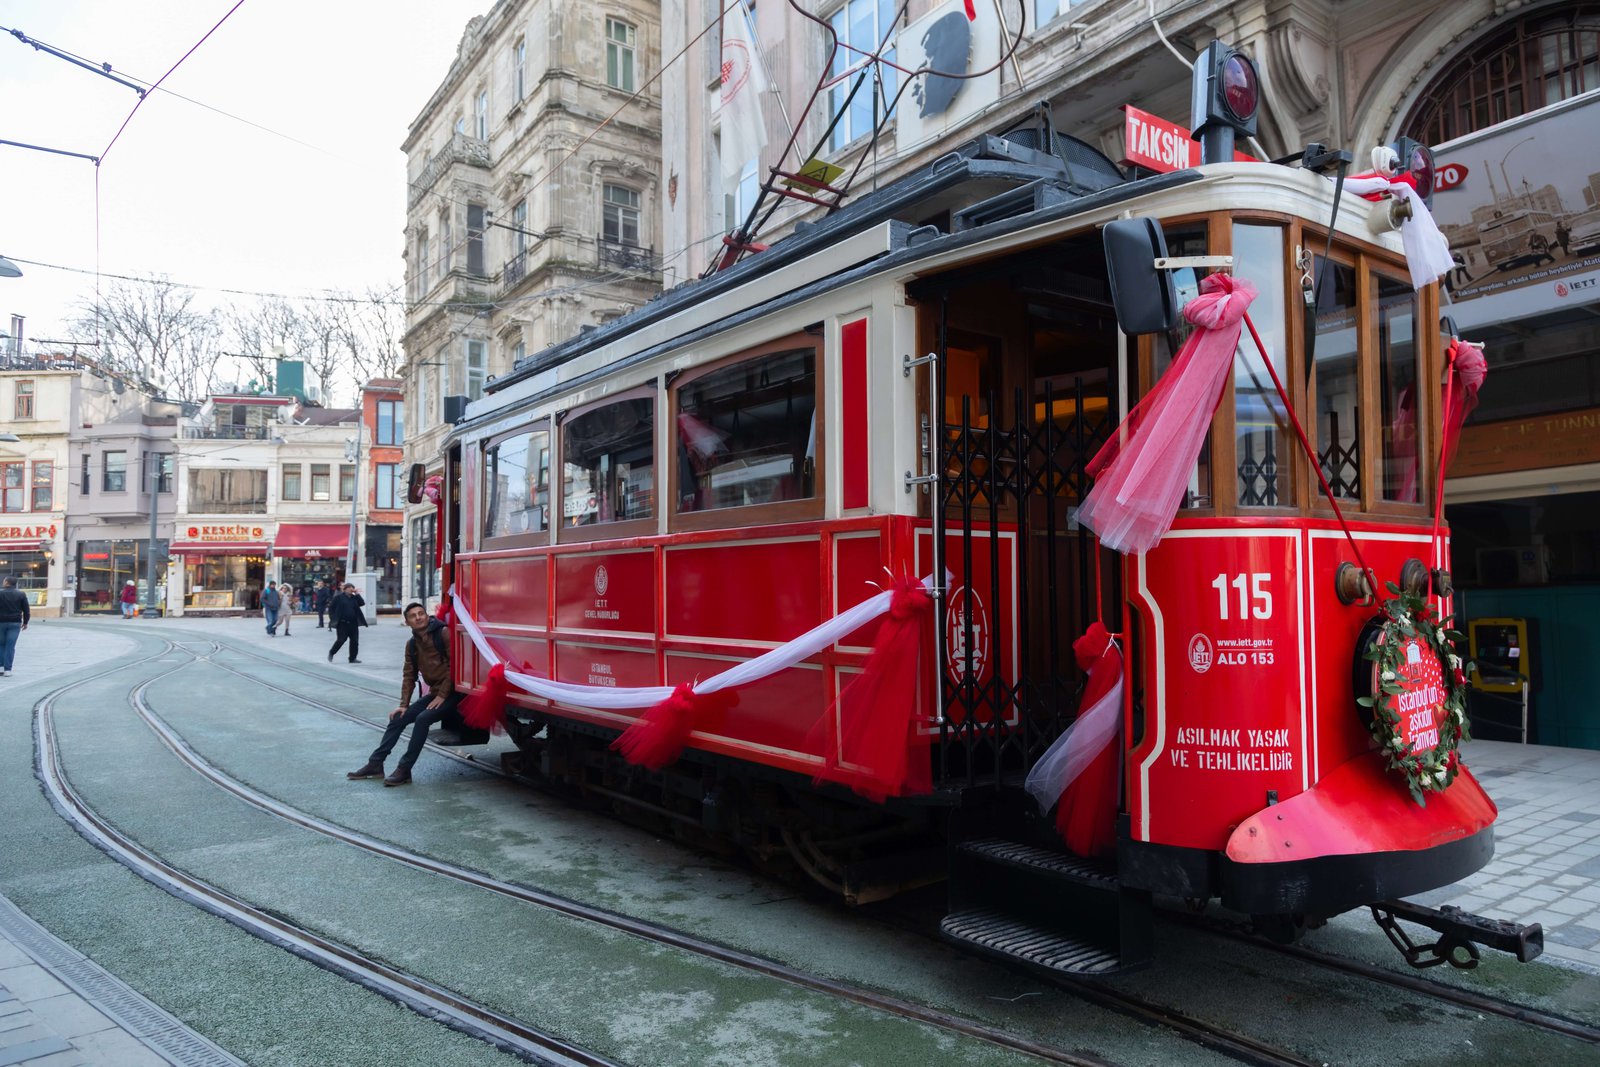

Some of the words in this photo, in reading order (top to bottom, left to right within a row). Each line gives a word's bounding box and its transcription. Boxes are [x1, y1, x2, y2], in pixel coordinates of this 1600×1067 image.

[1129, 116, 1190, 169] TAKSİM
[1212, 573, 1272, 620] 115
[1217, 638, 1273, 648] www.iett.gov.tr
[1217, 652, 1247, 665] ALO
[1251, 652, 1274, 665] 153
[1177, 727, 1240, 748] ASILMAK
[1248, 728, 1289, 748] YASAK
[1171, 749, 1189, 768] VE
[1197, 750, 1293, 771] TEHLİKELİDİR
